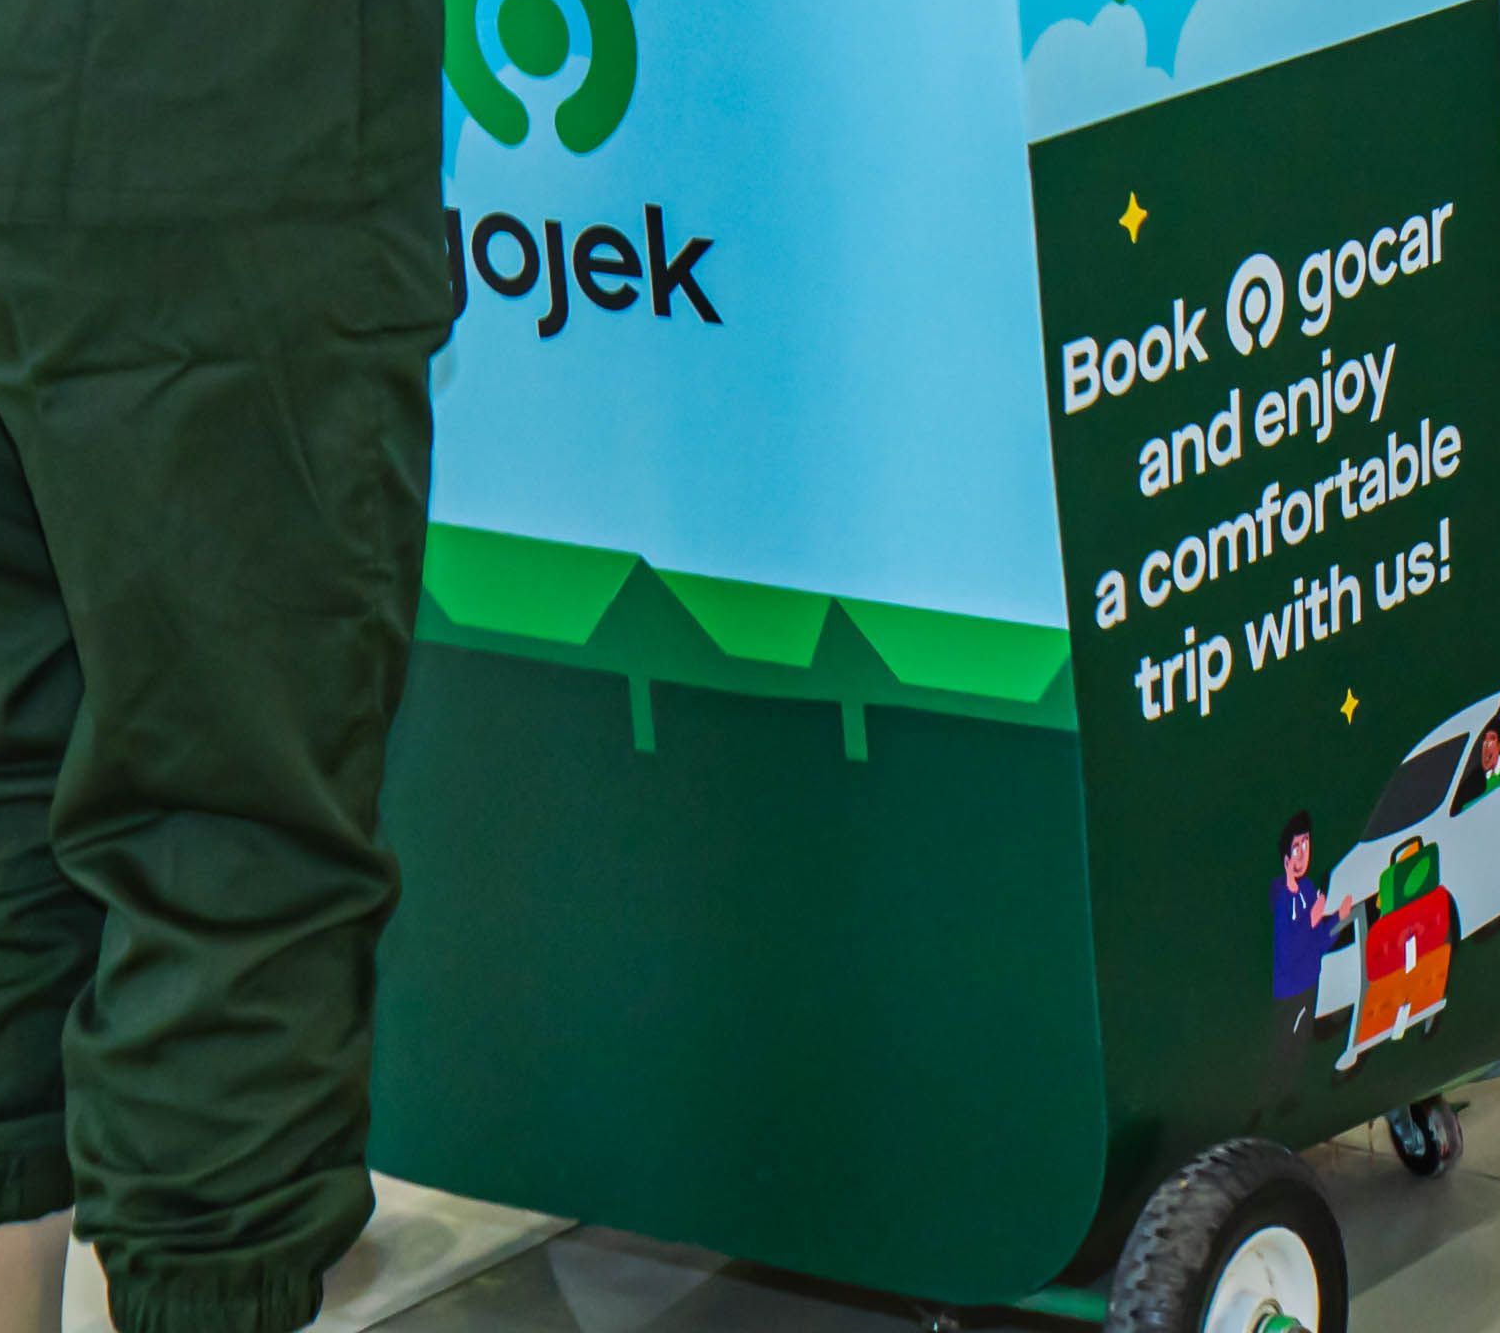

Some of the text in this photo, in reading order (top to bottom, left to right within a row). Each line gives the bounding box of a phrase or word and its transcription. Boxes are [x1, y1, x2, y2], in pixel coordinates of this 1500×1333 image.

[1063, 201, 1455, 415] Book gocar
[1095, 417, 1462, 630] a comfortable
[1138, 343, 1397, 498] and enjoy
[1134, 517, 1451, 721] trip with us!
